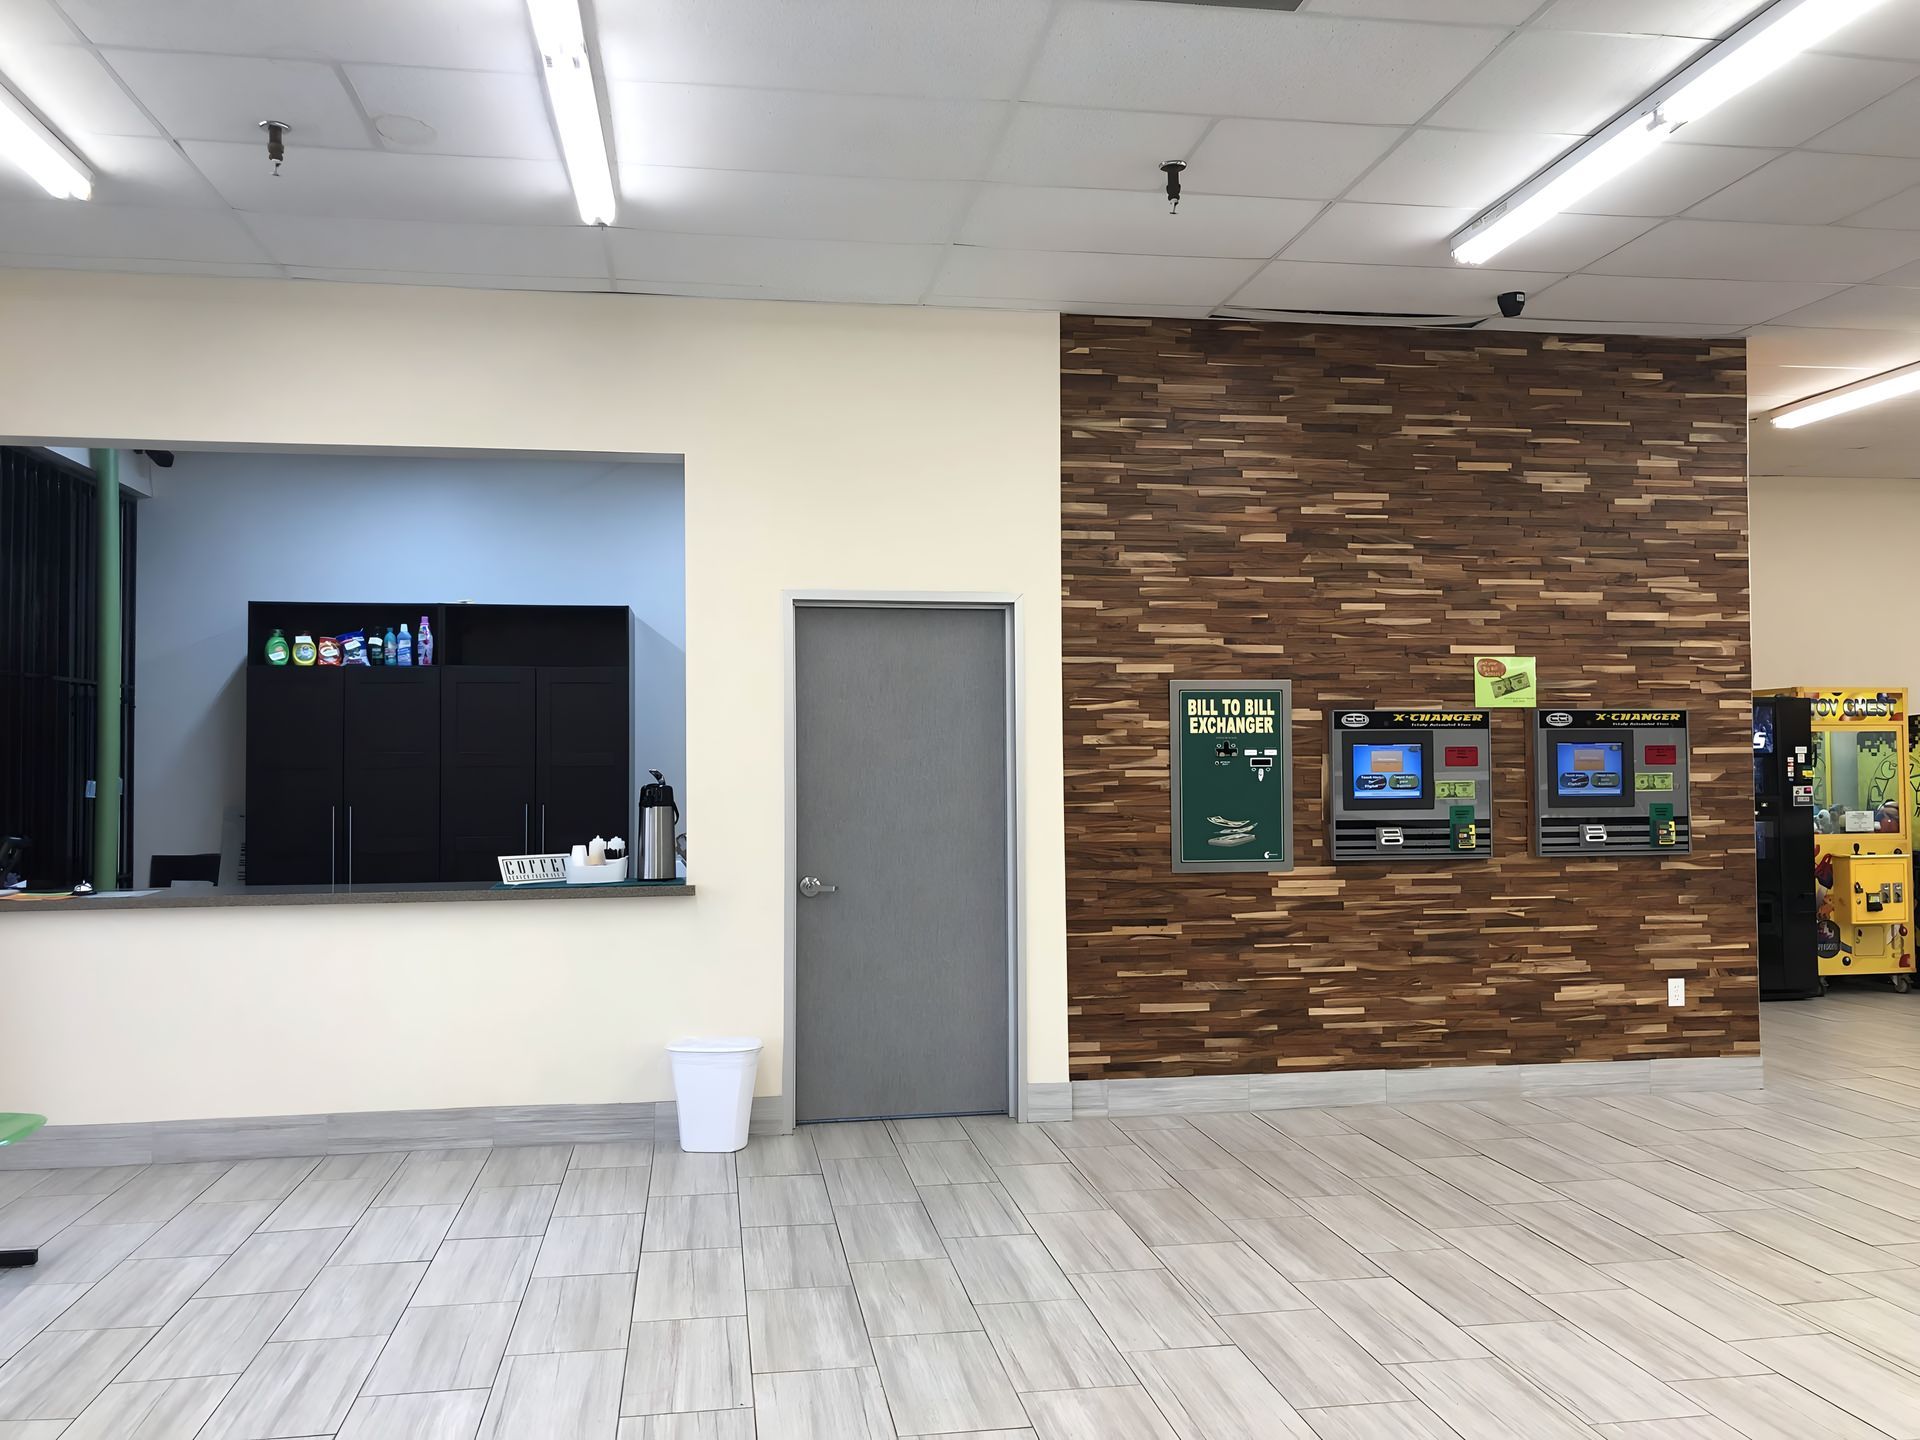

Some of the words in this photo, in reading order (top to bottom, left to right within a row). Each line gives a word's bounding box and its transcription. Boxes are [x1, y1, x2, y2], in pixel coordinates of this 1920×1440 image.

[1187, 699, 1218, 716] BILL
[1222, 699, 1241, 716] TO
[1244, 699, 1275, 716] BILL
[1811, 698, 1839, 717] TOY
[1843, 698, 1897, 717] CHEST
[1189, 716, 1274, 734] EXCHANGER
[1393, 713, 1483, 722] X-CHANGER
[1595, 713, 1681, 721] X-CHANGER
